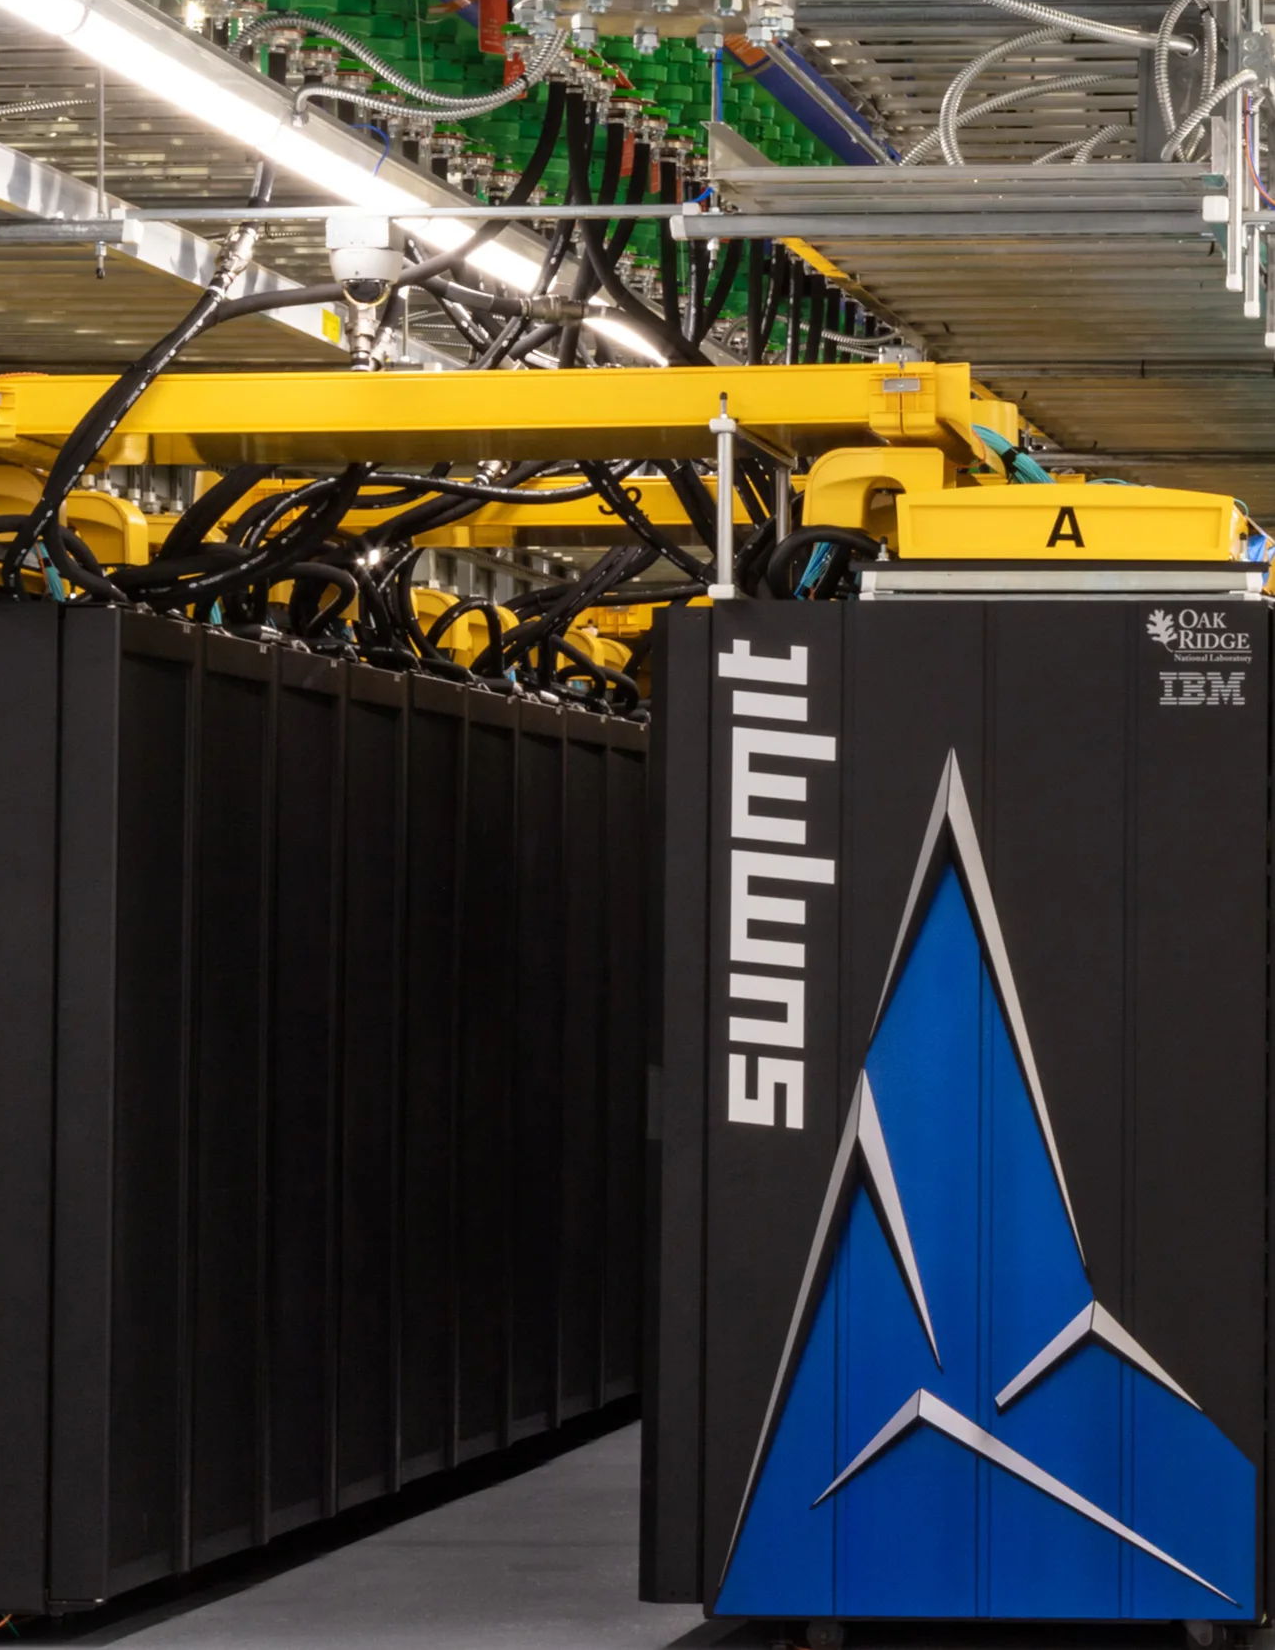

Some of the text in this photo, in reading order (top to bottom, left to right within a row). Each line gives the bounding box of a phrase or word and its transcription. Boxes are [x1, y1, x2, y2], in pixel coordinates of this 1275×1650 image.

[1045, 506, 1086, 548] A
[1173, 653, 1253, 664] National Laboratory
[1159, 671, 1246, 706] IBM
